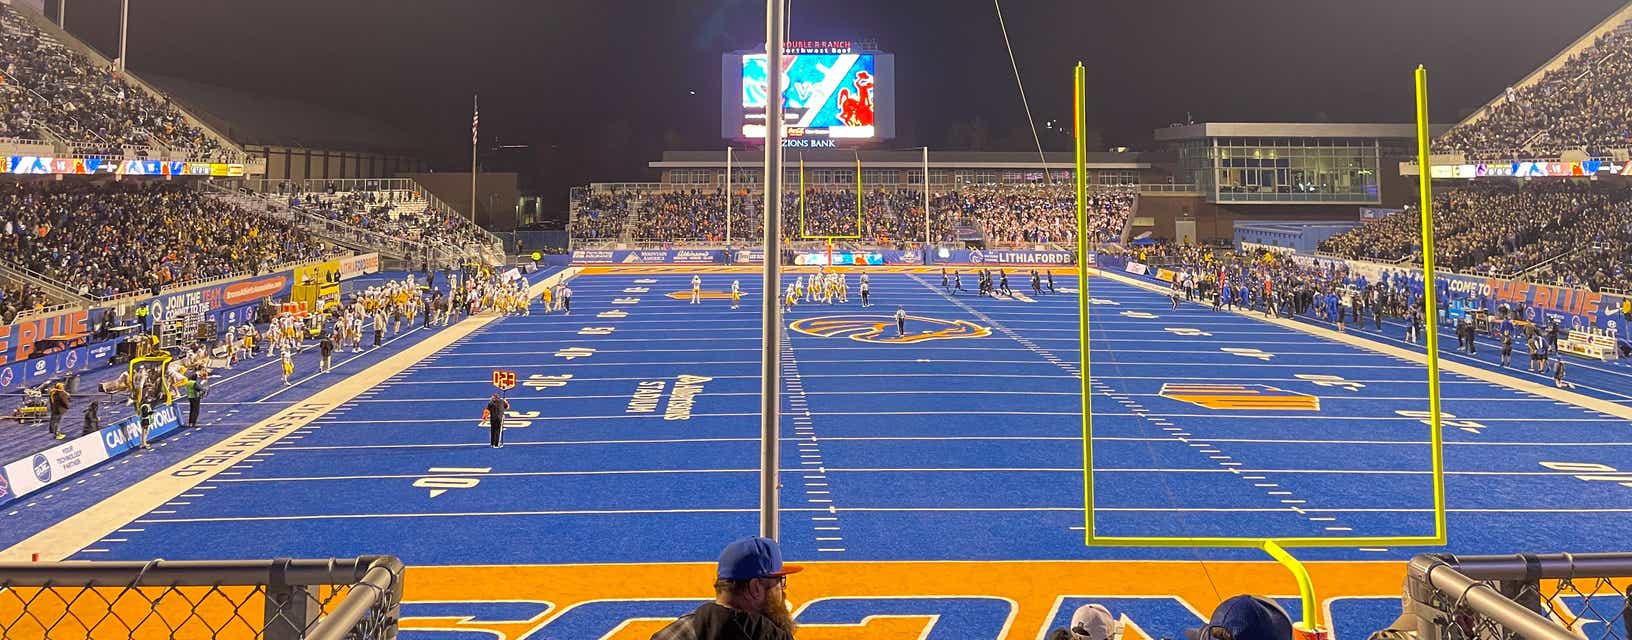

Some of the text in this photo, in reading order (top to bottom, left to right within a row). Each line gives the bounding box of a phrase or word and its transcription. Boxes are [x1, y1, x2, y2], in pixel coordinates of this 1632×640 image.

[782, 139, 836, 147] ZIONS BANK
[166, 294, 184, 310] JOIN
[186, 291, 200, 307] THE
[1479, 283, 1491, 297] TO
[625, 381, 666, 413] STADIUM
[106, 420, 145, 449] CAMPIN
[226, 421, 293, 447] SMITH
[171, 449, 245, 477] FIELD
